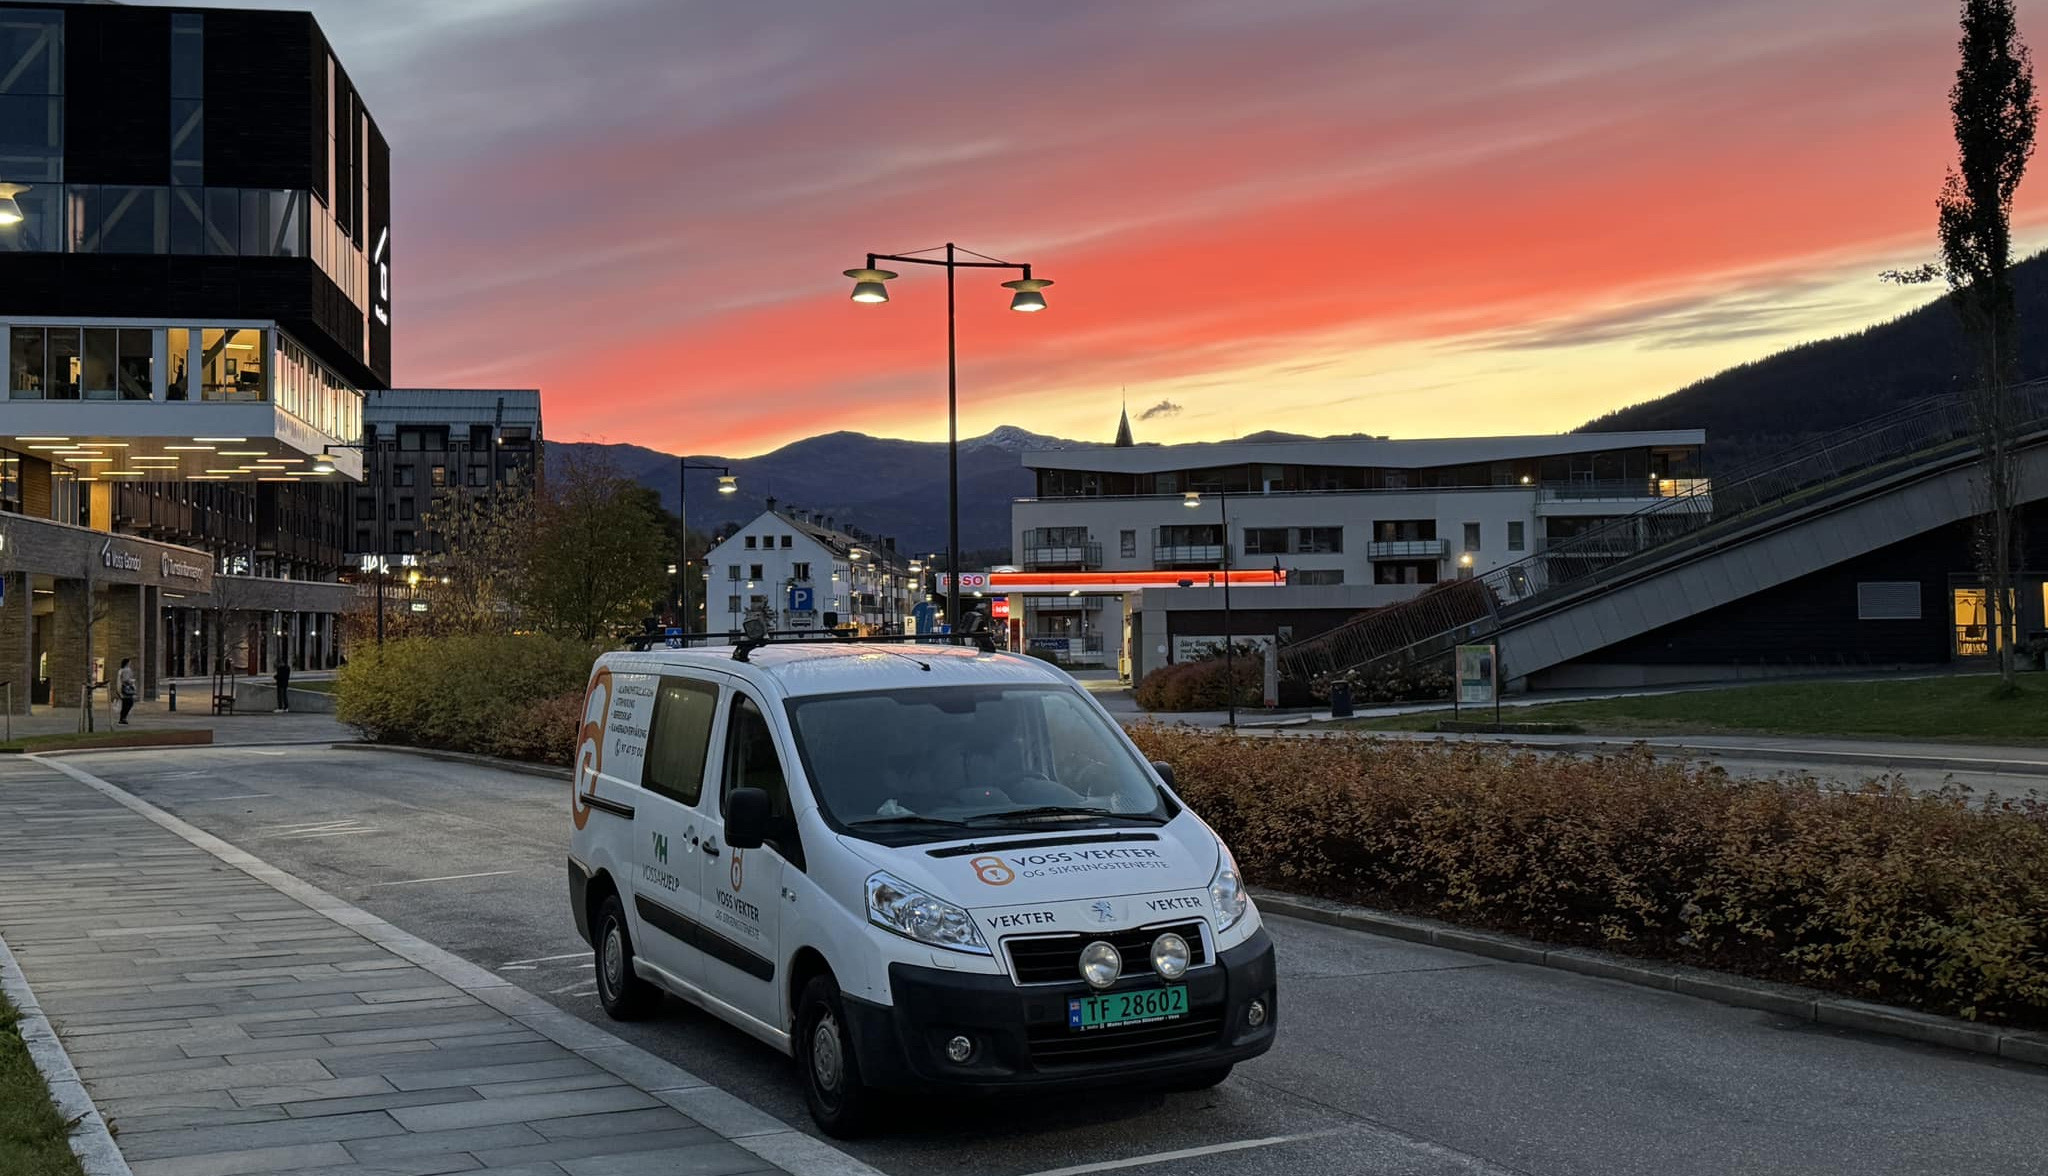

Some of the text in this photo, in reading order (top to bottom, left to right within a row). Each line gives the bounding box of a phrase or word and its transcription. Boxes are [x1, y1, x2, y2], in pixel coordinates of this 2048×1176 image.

[942, 575, 984, 586] ESO
[794, 590, 808, 609] P
[1011, 848, 1161, 868] VOSS VEKTER
[1022, 860, 1170, 878] OG SIKRINGSTENESTE
[716, 888, 760, 923] VOSS VEKTER
[1146, 896, 1203, 911] VEKTER
[987, 911, 1056, 929] VEKTER
[1087, 989, 1182, 1021] TF 28602
[1072, 1015, 1079, 1023] N
